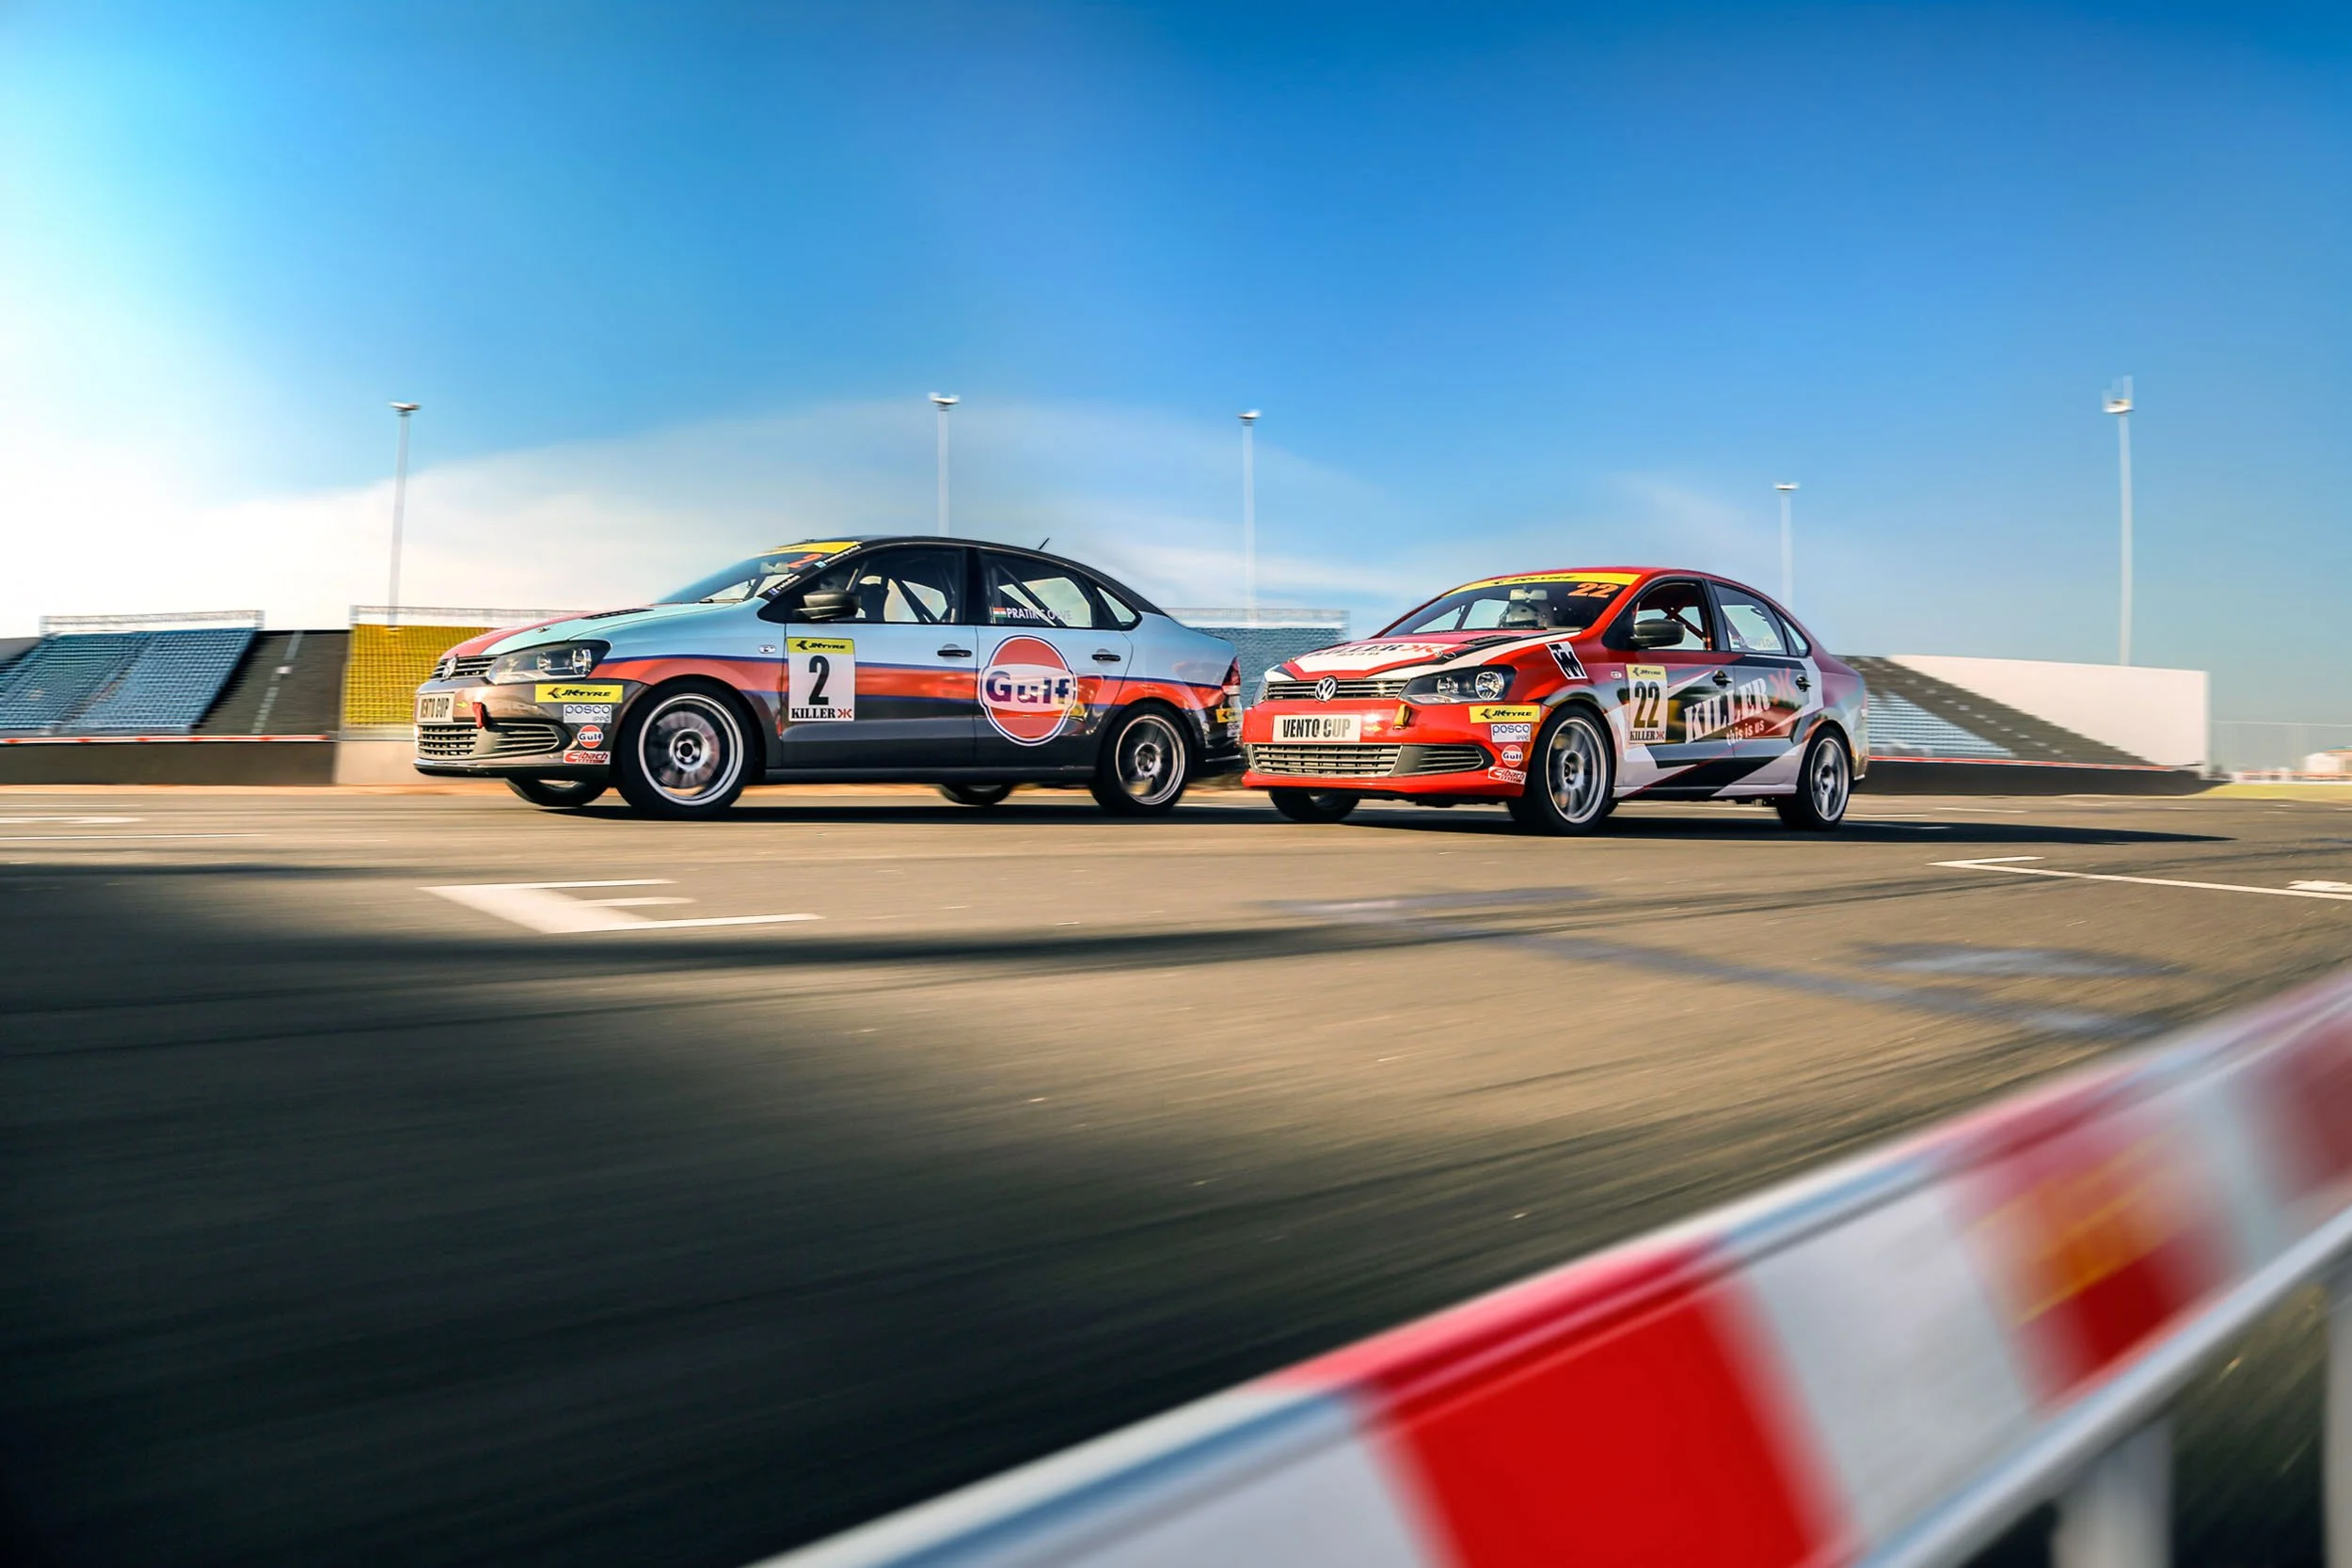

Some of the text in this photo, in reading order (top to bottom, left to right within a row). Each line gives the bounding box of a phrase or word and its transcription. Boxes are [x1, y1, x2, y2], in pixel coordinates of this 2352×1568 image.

[1567, 582, 1619, 598] 22
[808, 655, 831, 705] 2
[986, 670, 1071, 704] Gulf
[565, 705, 611, 717] posco
[790, 707, 836, 720] KILLER
[1633, 680, 1660, 728] 22
[1684, 677, 1771, 744] KILLER
[1283, 718, 1351, 737] VENTO CUP
[1492, 724, 1530, 736] posco
[1629, 730, 1656, 741] KILLER
[1726, 720, 1765, 746] this is us
